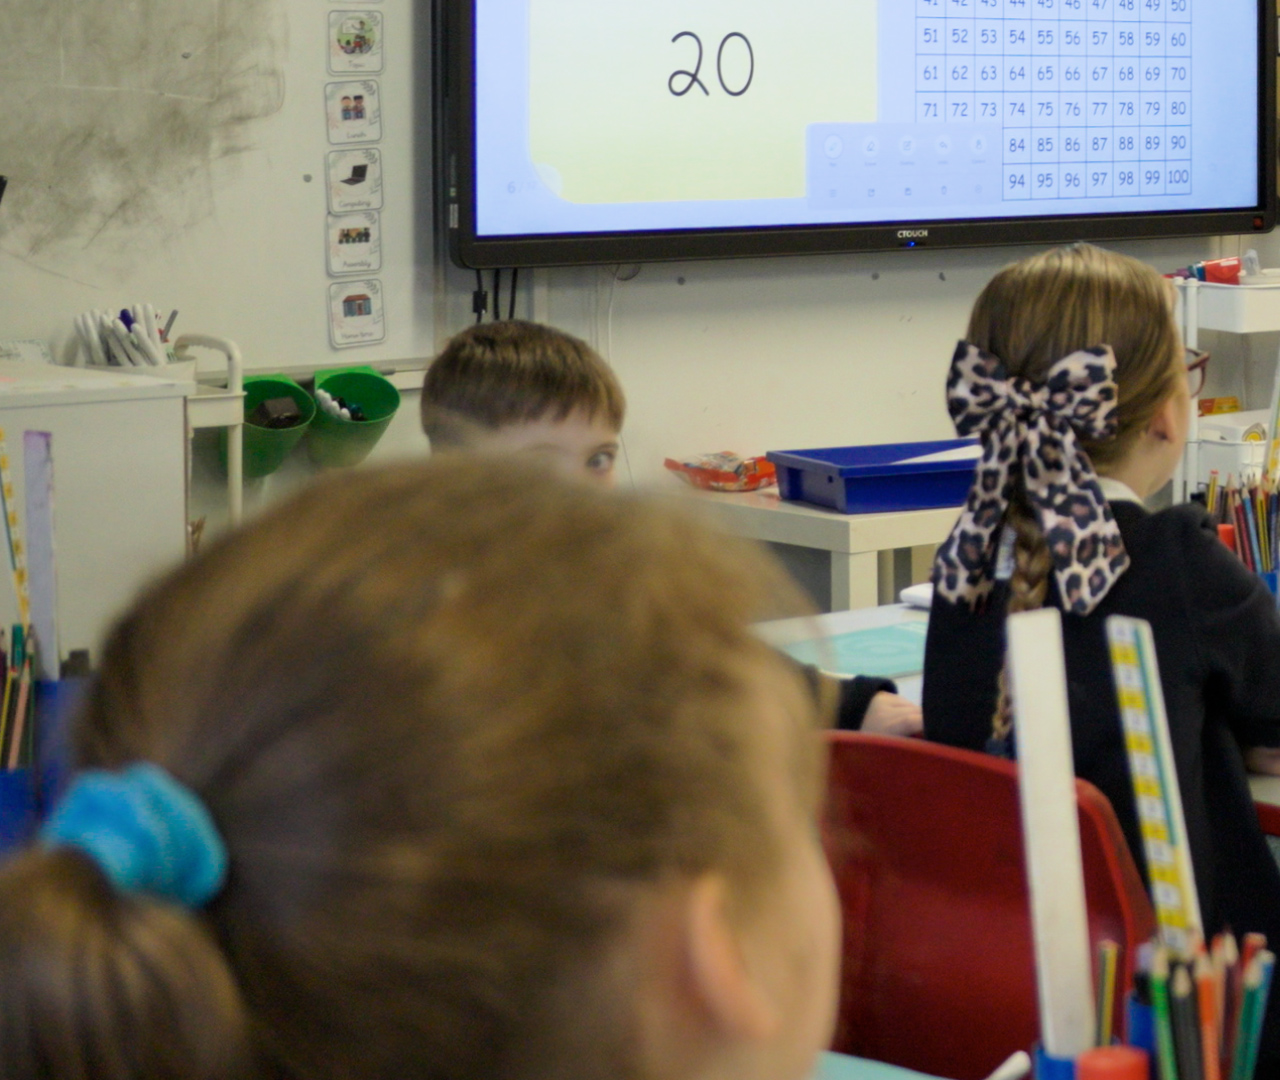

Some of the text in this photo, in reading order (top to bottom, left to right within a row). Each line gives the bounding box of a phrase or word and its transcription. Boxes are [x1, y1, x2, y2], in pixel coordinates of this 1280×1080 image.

[668, 31, 754, 97] 20
[951, 65, 969, 81] 62
[1118, 138, 1135, 153] 88
[1167, 169, 1190, 186] 100
